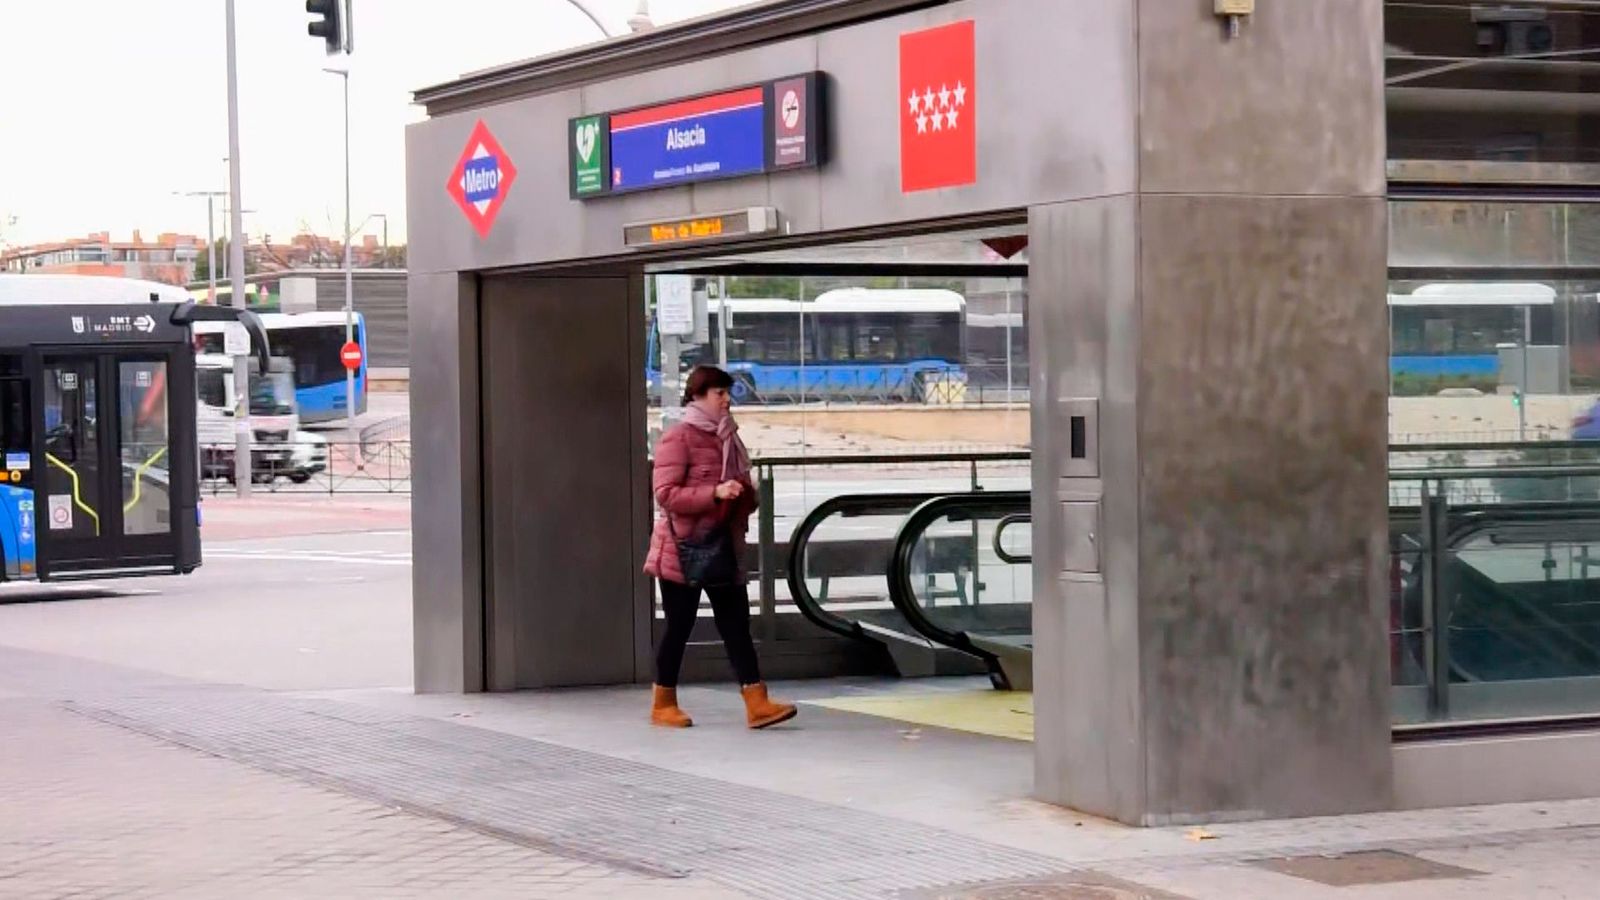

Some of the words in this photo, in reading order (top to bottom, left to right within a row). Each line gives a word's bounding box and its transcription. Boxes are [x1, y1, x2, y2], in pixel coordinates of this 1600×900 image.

[666, 124, 706, 150] Alsacia
[466, 168, 497, 193] Metro
[110, 316, 130, 324] EMT
